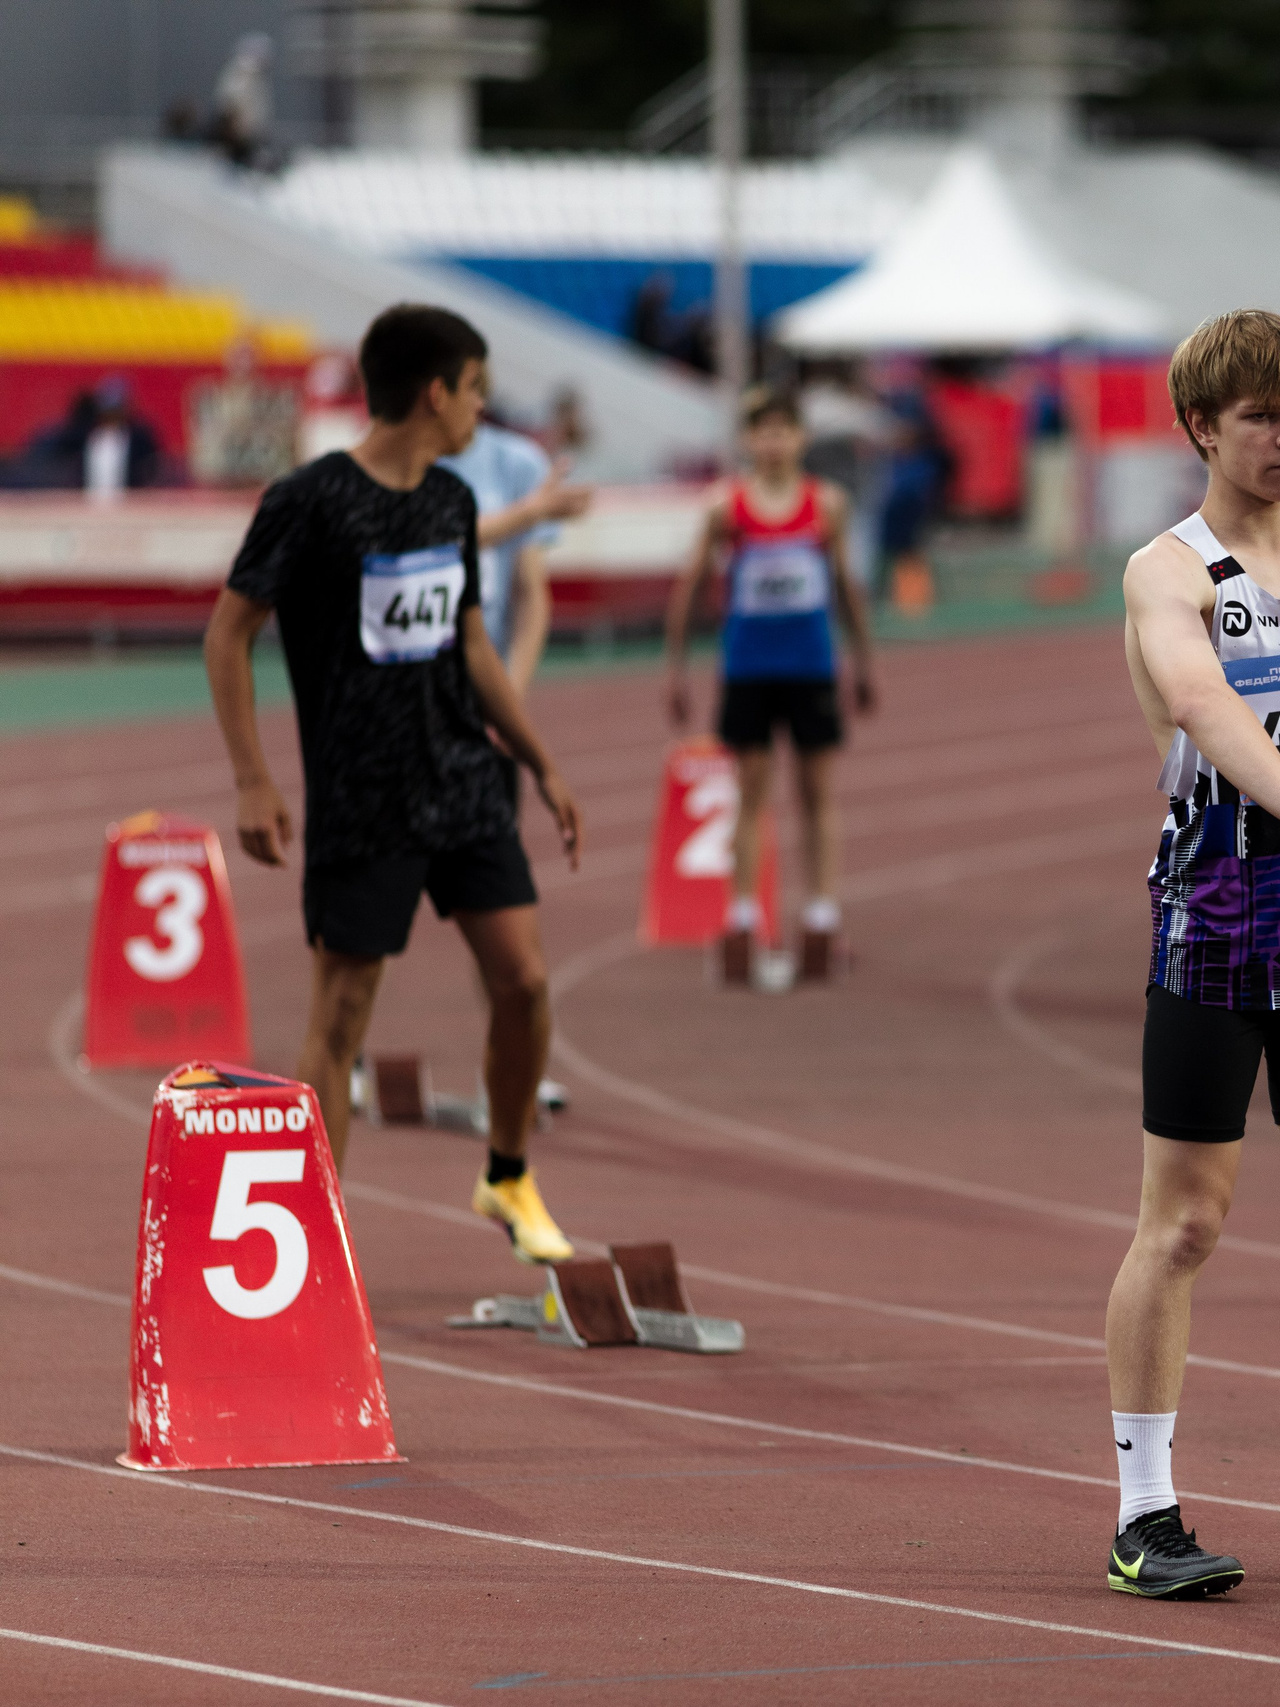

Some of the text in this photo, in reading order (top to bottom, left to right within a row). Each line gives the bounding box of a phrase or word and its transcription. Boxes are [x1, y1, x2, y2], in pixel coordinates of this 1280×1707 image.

[384, 585, 449, 632] 447
[674, 773, 741, 879] 2
[123, 867, 208, 983] 3
[185, 1106, 307, 1135] MONDO
[202, 1149, 309, 1320] 5
